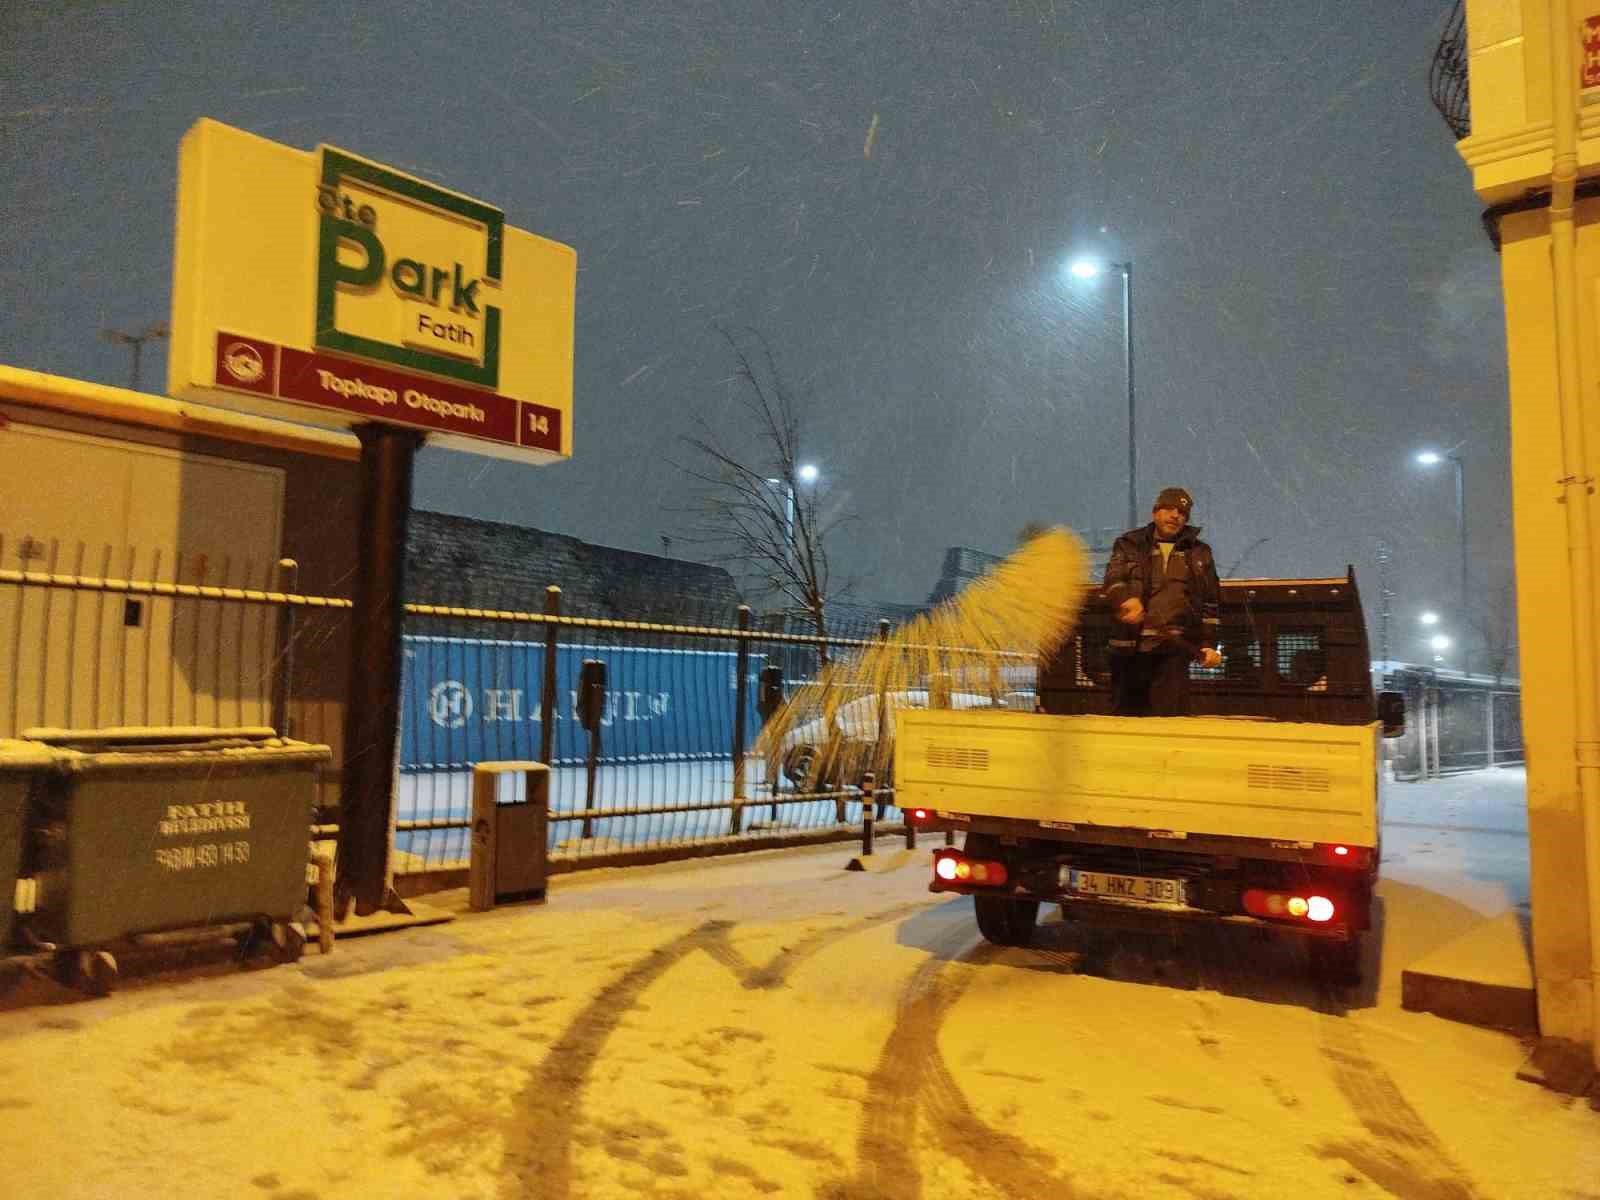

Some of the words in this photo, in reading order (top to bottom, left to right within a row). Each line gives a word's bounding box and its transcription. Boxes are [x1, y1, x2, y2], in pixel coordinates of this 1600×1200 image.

[418, 314, 475, 347] Fatih
[528, 411, 549, 434] 14
[1080, 873, 1098, 892] 34
[1143, 879, 1175, 899] 309
